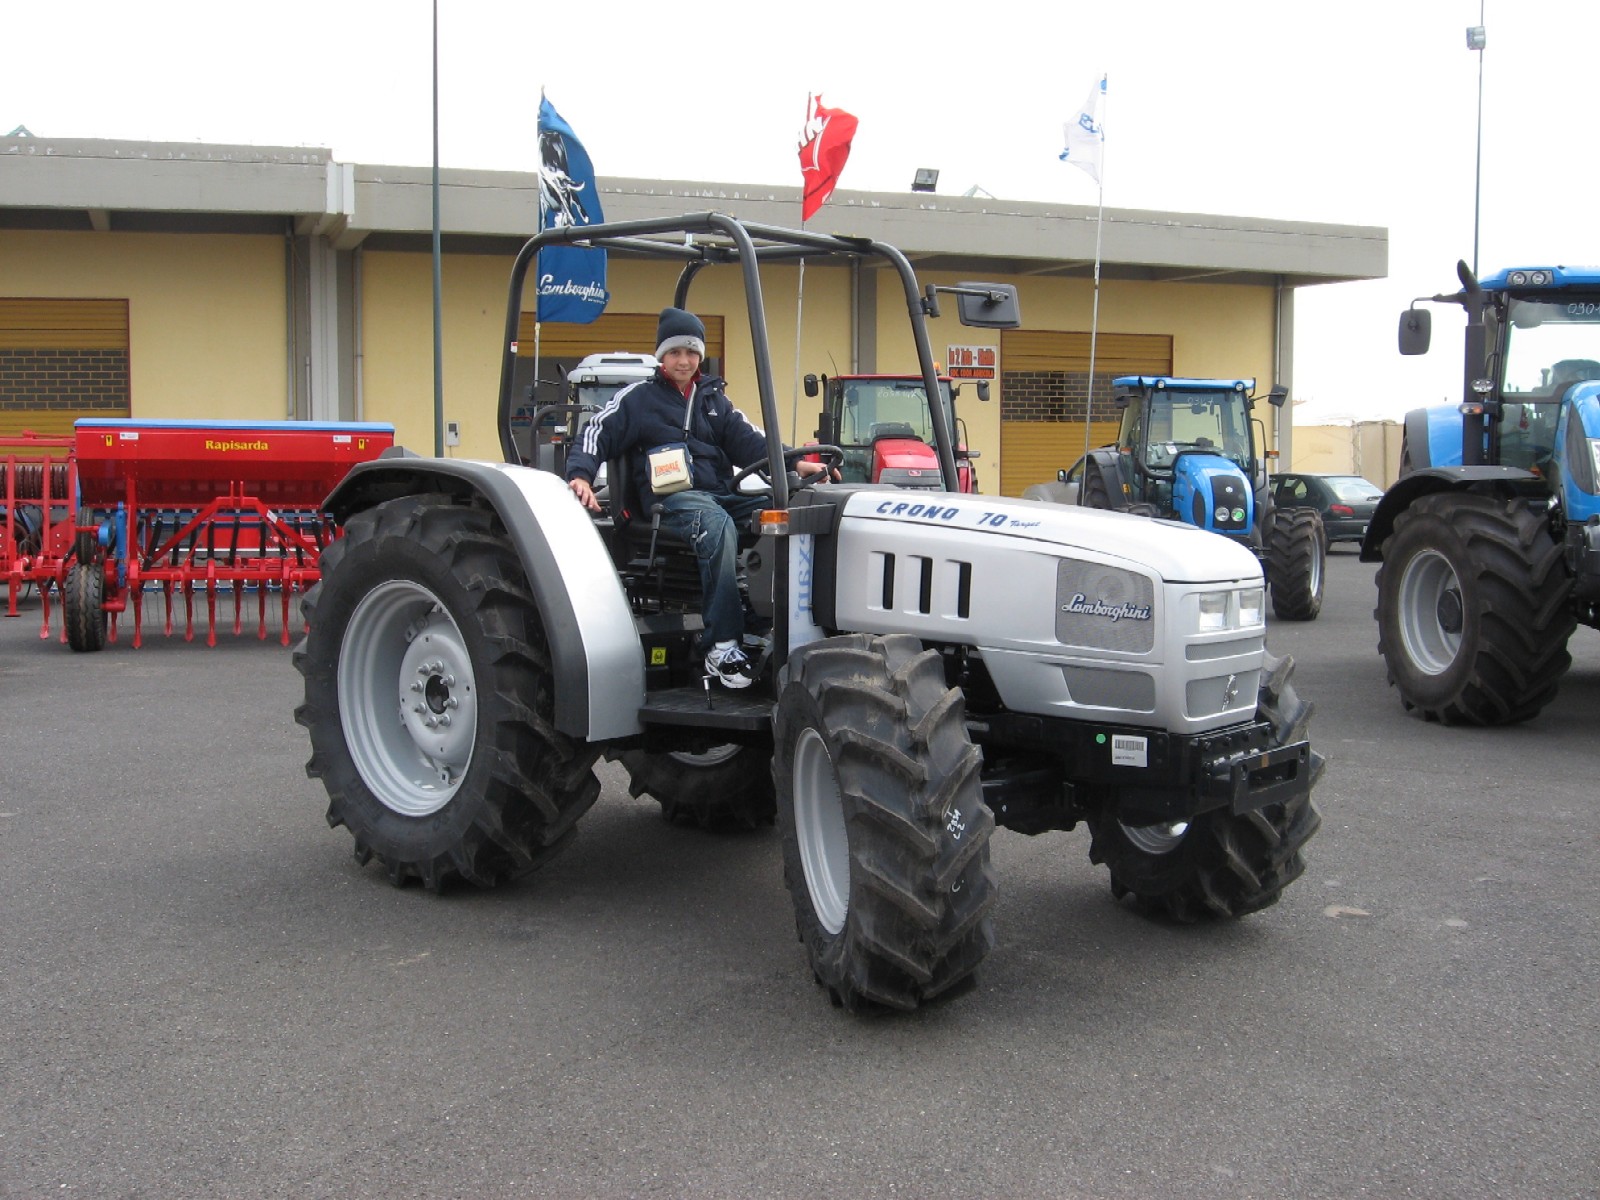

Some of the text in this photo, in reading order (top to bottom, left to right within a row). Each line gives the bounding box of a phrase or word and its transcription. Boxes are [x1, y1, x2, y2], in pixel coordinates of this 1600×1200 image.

[537, 274, 605, 301] Lamborghin
[205, 440, 269, 451] Rapisarda
[876, 501, 960, 520] CRONO
[976, 512, 1008, 526] 70
[1061, 592, 1149, 622] Lamborghini
